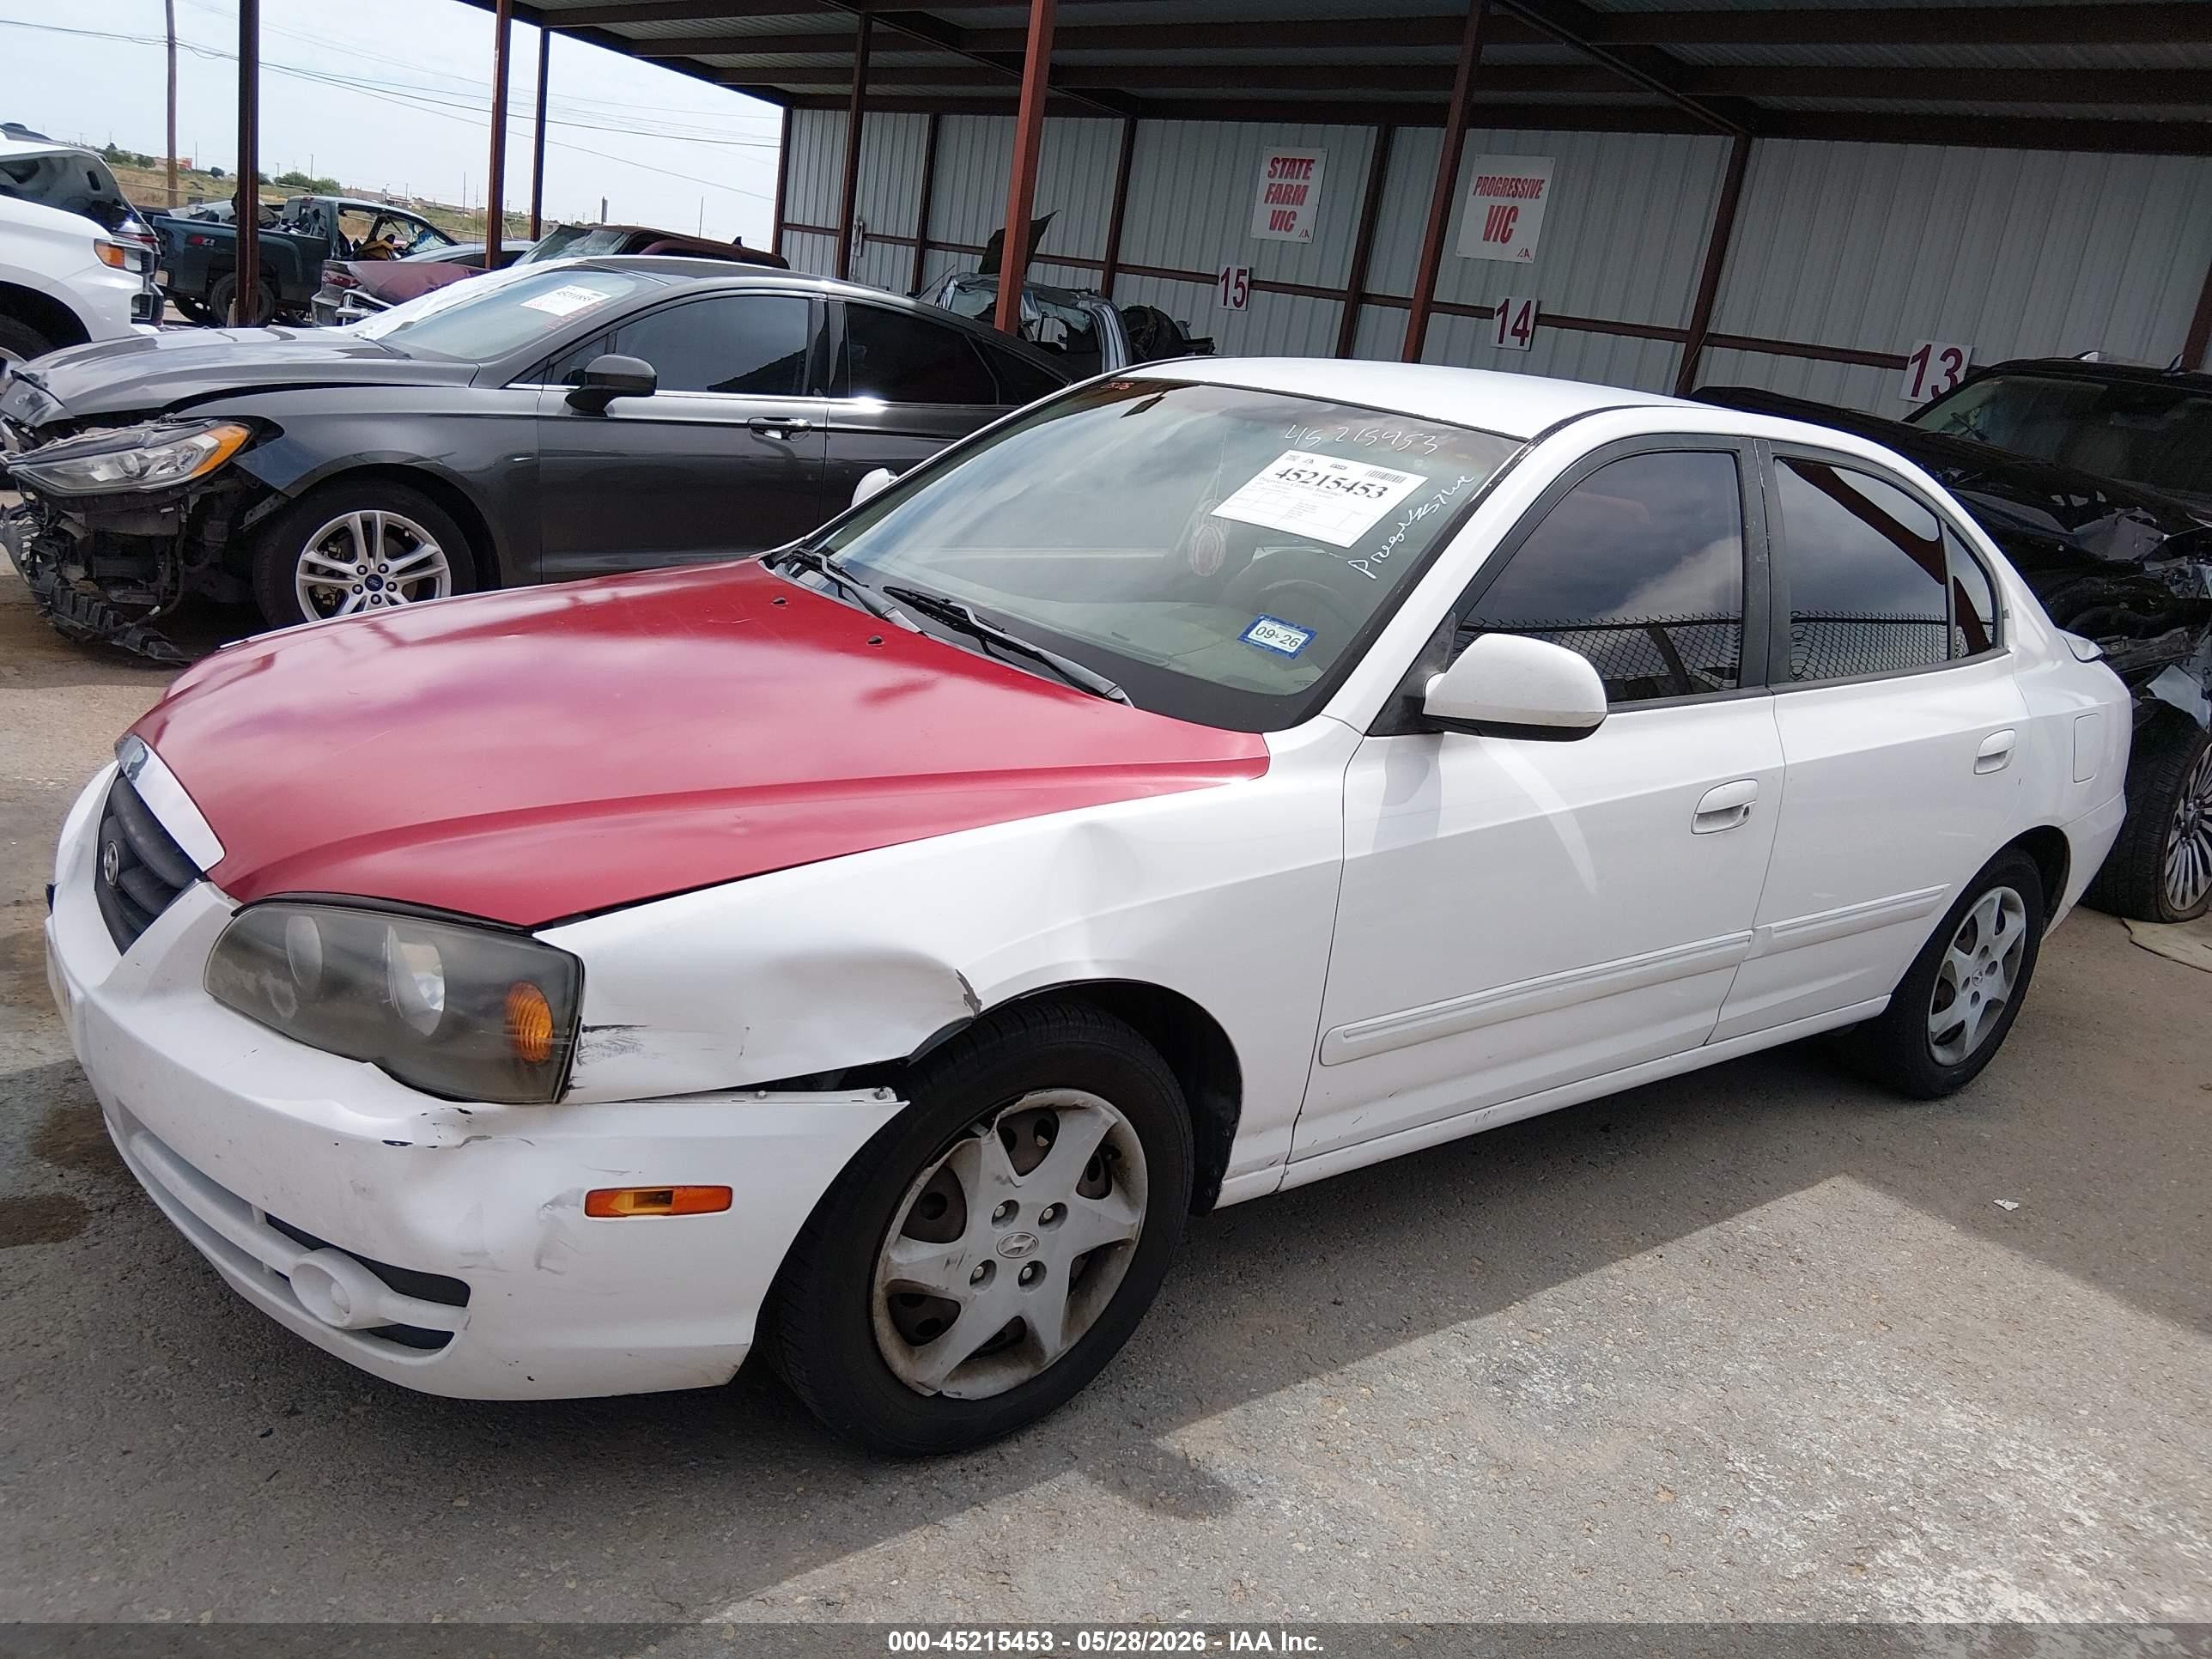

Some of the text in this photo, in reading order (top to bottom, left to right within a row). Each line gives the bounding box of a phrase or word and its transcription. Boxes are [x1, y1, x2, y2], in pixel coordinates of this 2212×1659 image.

[1267, 157, 1316, 180] STATE
[1264, 183, 1309, 206] FARM
[1473, 176, 1546, 199] PROGRESSIVE
[1269, 210, 1297, 233] VIC
[1483, 205, 1518, 244] VIC
[1220, 266, 1248, 308] 15
[1496, 298, 1532, 346] 14
[1910, 344, 1963, 398] 13
[1275, 467, 1389, 499] 45215453
